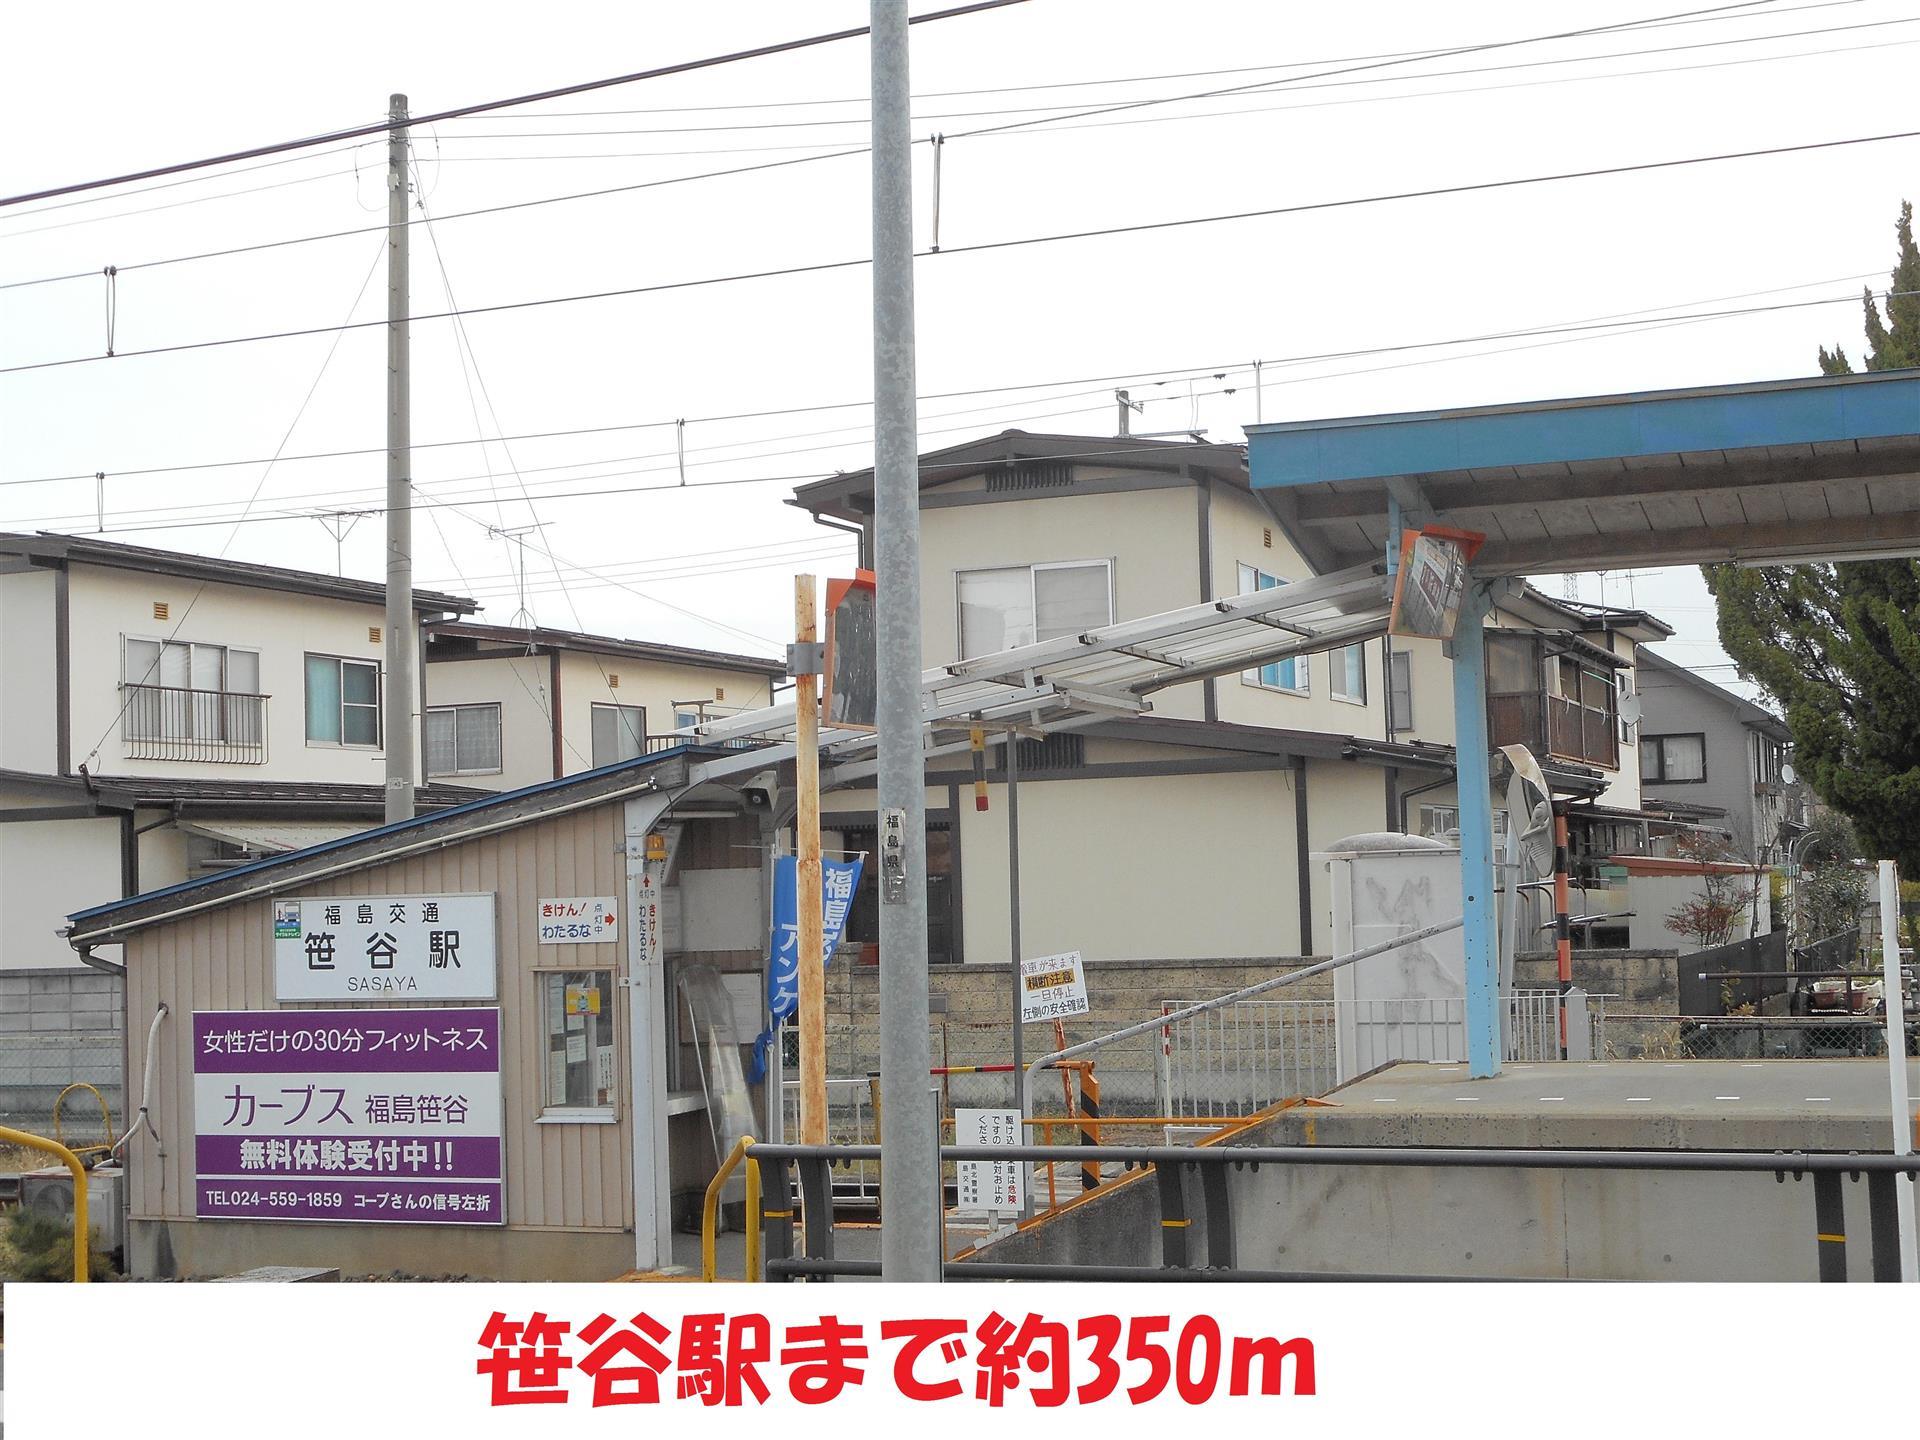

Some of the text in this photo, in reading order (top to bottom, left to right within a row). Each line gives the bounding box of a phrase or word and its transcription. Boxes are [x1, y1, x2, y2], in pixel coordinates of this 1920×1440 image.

[886, 815, 899, 868] 福島県
[325, 902, 440, 925] 福島交通
[542, 902, 587, 917] きけん!
[542, 924, 591, 939] わたるな
[639, 904, 647, 961] わたるな
[304, 930, 462, 970] 笹谷駅
[347, 976, 418, 992] SASAYA
[1026, 970, 1074, 990] 横断注意
[1030, 985, 1076, 1002] 一旦停止
[1023, 997, 1087, 1020] 左側の安全確認
[202, 1027, 489, 1054] 女性だけの30分フィットネス
[222, 1084, 469, 1127] カーブス 福島笹谷
[239, 1139, 454, 1172] 無料体験受付中!!
[205, 1190, 491, 1212] TEL024-559-1859 コープさんの信号左折
